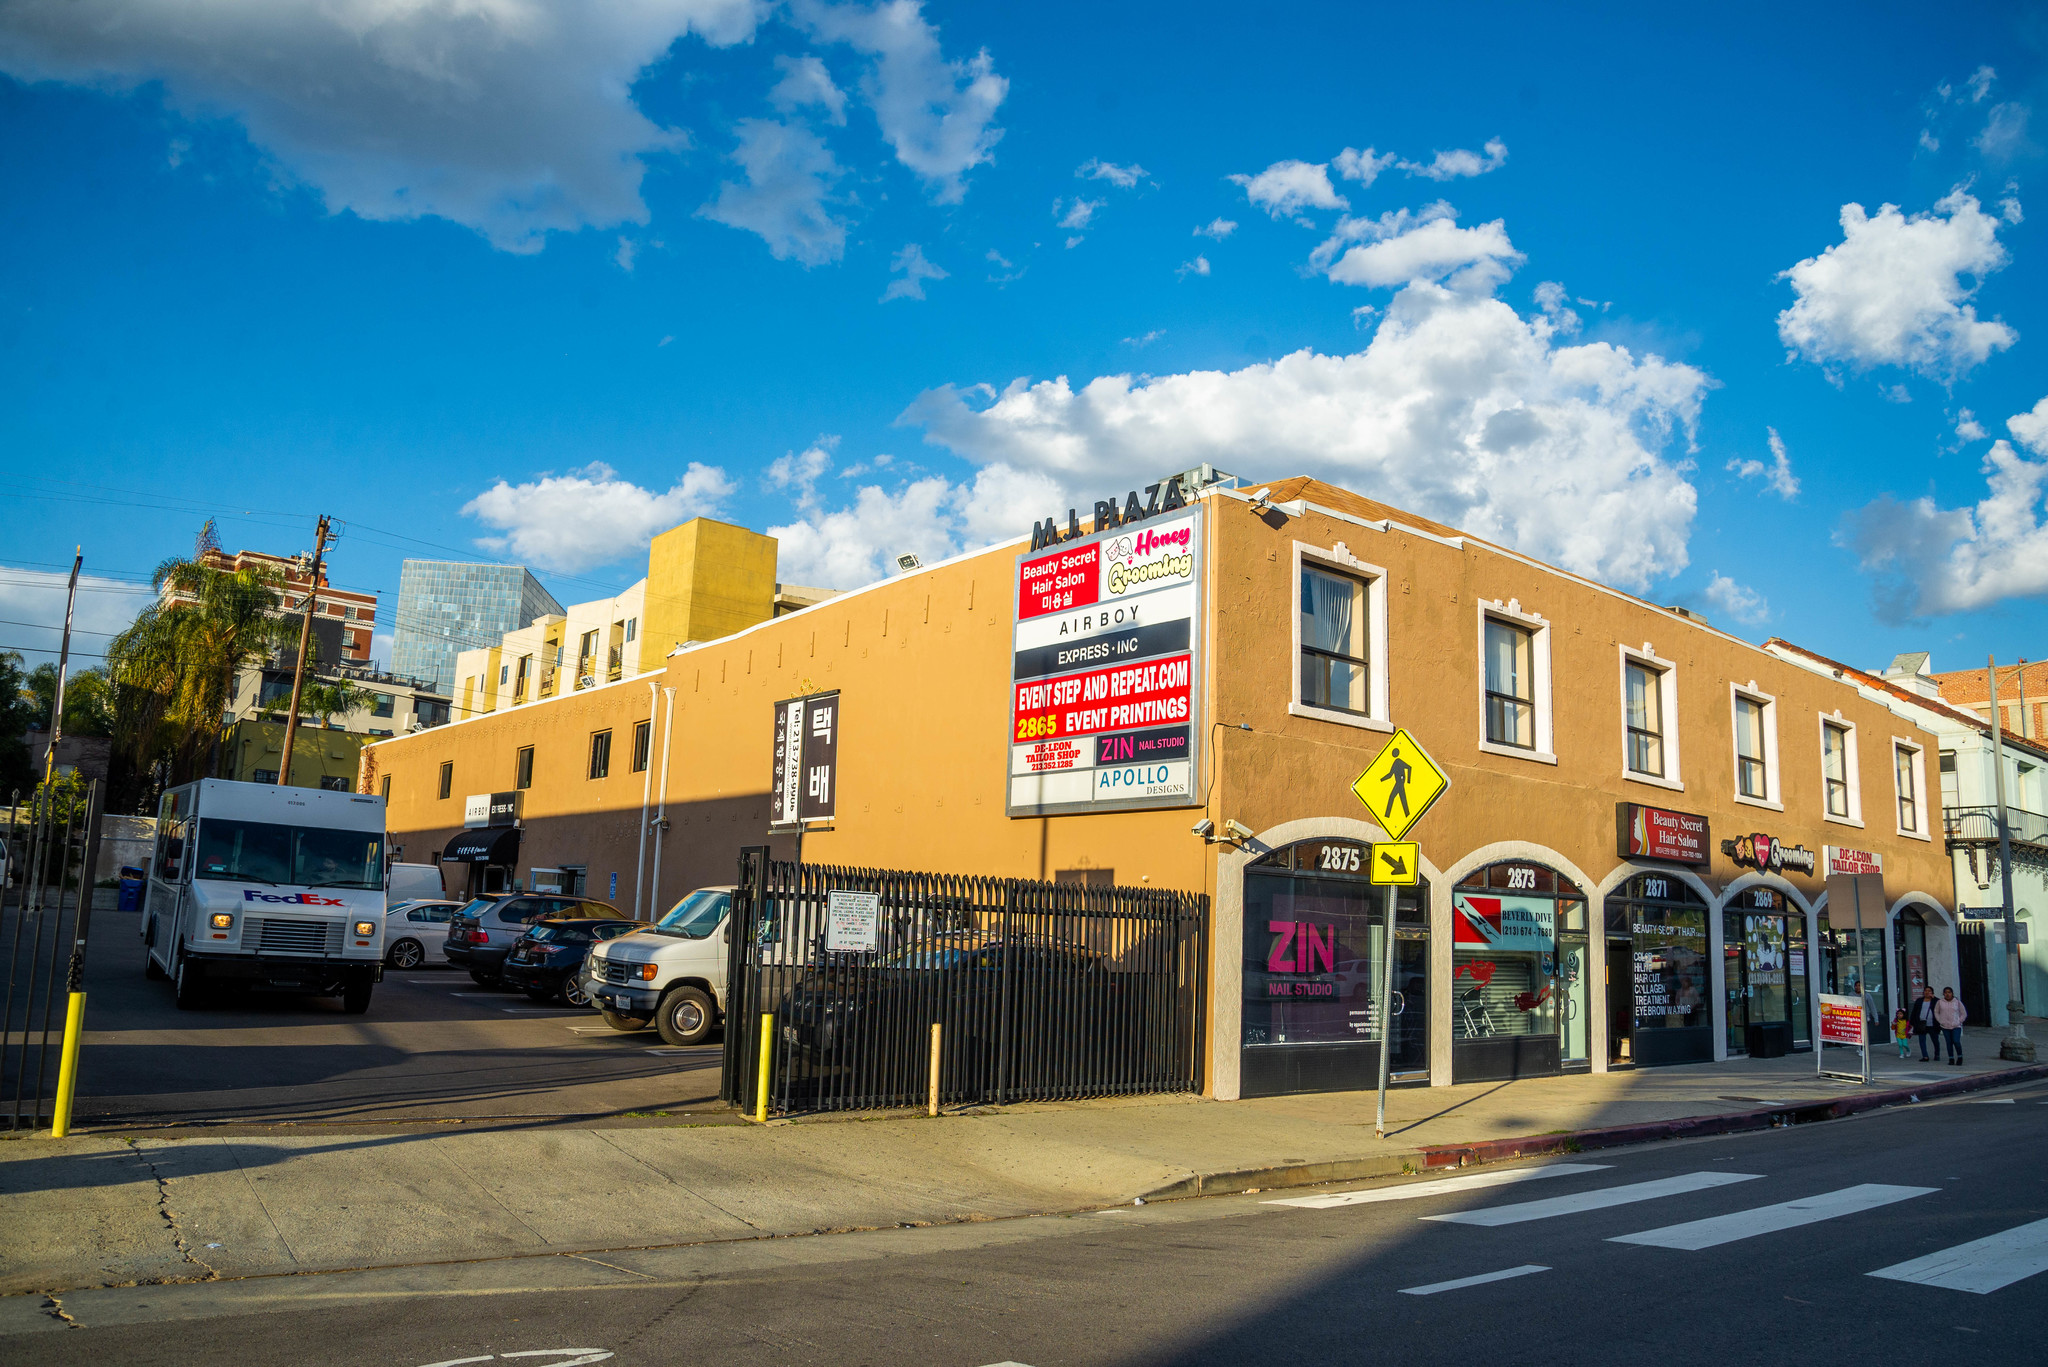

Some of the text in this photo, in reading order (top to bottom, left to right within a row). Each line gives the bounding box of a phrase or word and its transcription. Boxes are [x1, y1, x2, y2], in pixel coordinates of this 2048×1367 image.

[1094, 478, 1186, 532] PLAZA
[1134, 527, 1190, 556] Honey
[1023, 549, 1096, 580] Beauty Secret
[1108, 554, 1192, 594] Grooming
[1032, 572, 1085, 596] Hair Salon
[1042, 590, 1072, 610] 미용실
[1058, 637, 1138, 665] EXPRESS INC
[1018, 660, 1188, 712] EVENT STEP AND REPEAT.COM
[1017, 696, 1188, 739] 2865 EVENT PRINTINGS
[809, 706, 832, 804] 택배
[1026, 749, 1080, 764] TAILOR SHOP
[1034, 741, 1072, 754] DE-LEON
[1100, 736, 1184, 762] ZIN NAIL STUDIO
[1100, 765, 1169, 788] APOLLO
[1146, 784, 1184, 795] DESIGNS
[1653, 812, 1703, 832] Beauty Secret
[1659, 830, 1698, 848] Hair Salon
[1321, 846, 1360, 872] 2875
[1770, 838, 1814, 870] Grooming
[1840, 848, 1872, 864] DE-LEON
[1832, 858, 1880, 874] TAILOR SHOP
[1507, 868, 1535, 888] 2873
[1646, 878, 1667, 898] 2871
[243, 890, 346, 907] FedEx
[1754, 890, 1773, 908] 2869
[1502, 910, 1552, 923] BEVERLY DIVE
[1502, 926, 1519, 936] (213)
[1520, 926, 1532, 936] 674
[1632, 924, 1657, 934] BEAUTY
[1658, 925, 1682, 936] SECRT
[1682, 926, 1696, 936] HAIR
[1268, 920, 1334, 973] ZIN
[1634, 973, 1660, 984] HAIR CUT
[1269, 983, 1332, 996] NAIL STUDIO
[1634, 995, 1670, 1005] TREATMENT
